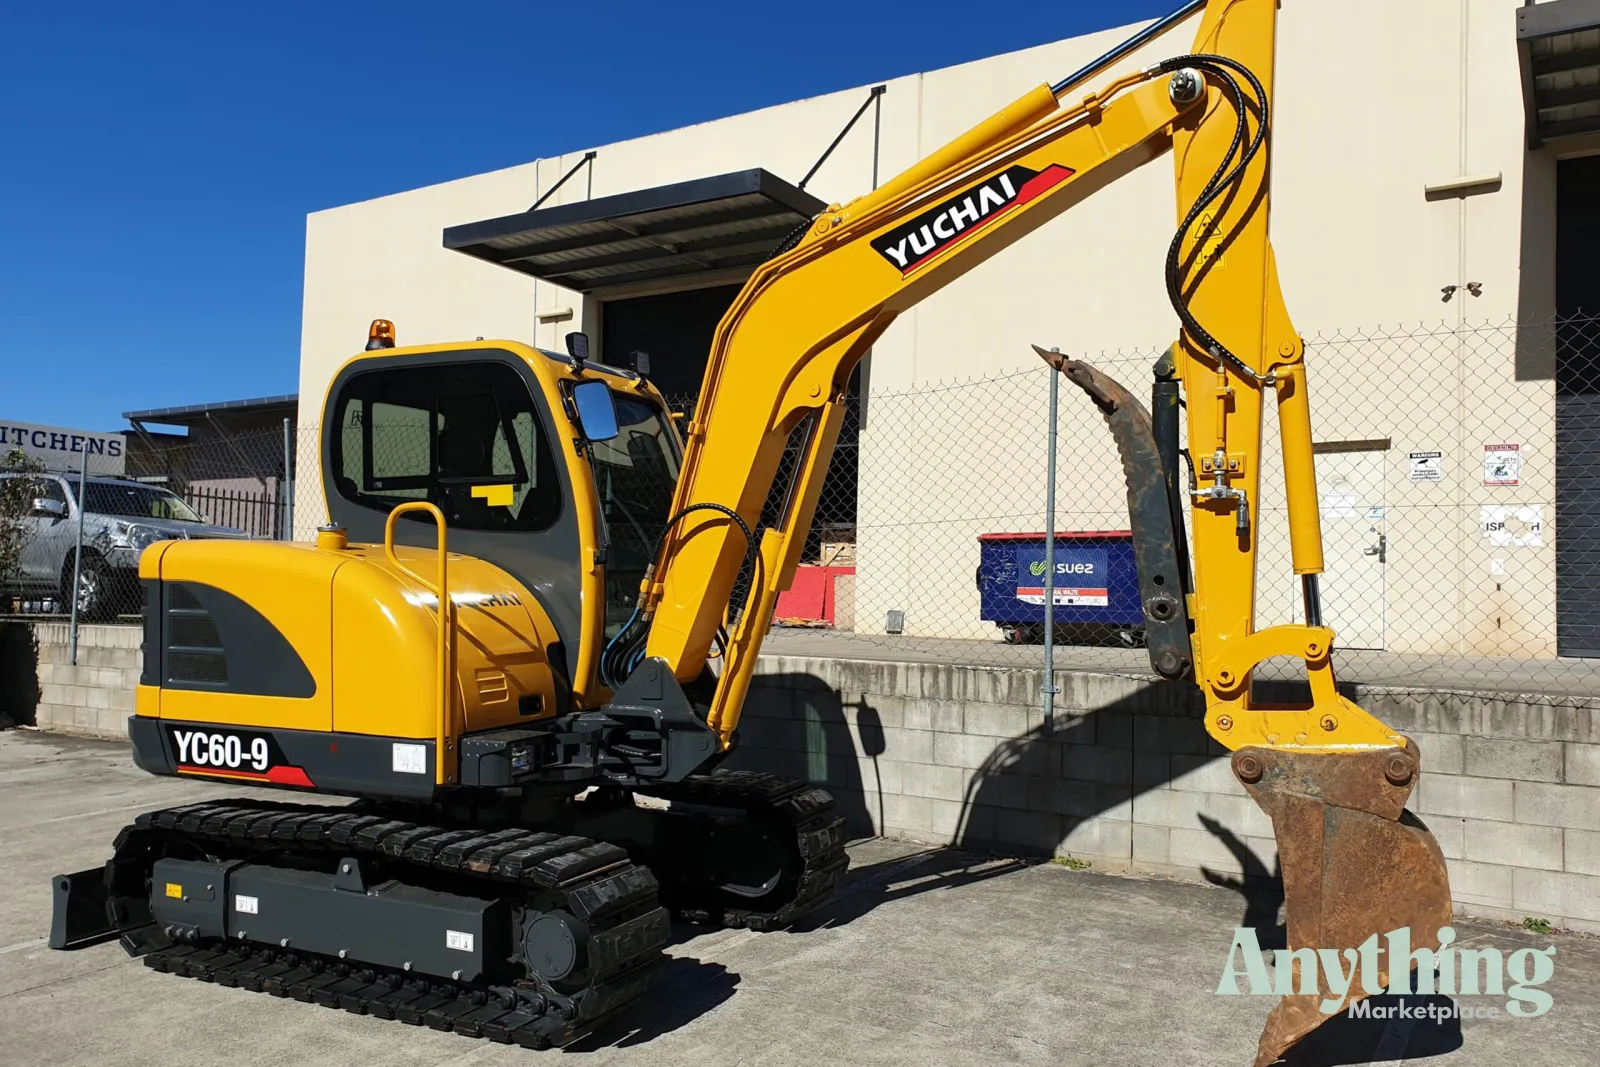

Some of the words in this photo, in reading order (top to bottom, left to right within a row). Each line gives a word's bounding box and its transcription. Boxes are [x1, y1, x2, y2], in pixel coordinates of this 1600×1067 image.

[885, 173, 1017, 267] YUCHAI
[0, 426, 121, 457] ITCHENS
[1056, 563, 1094, 574] suez
[174, 730, 268, 771] YC60-9
